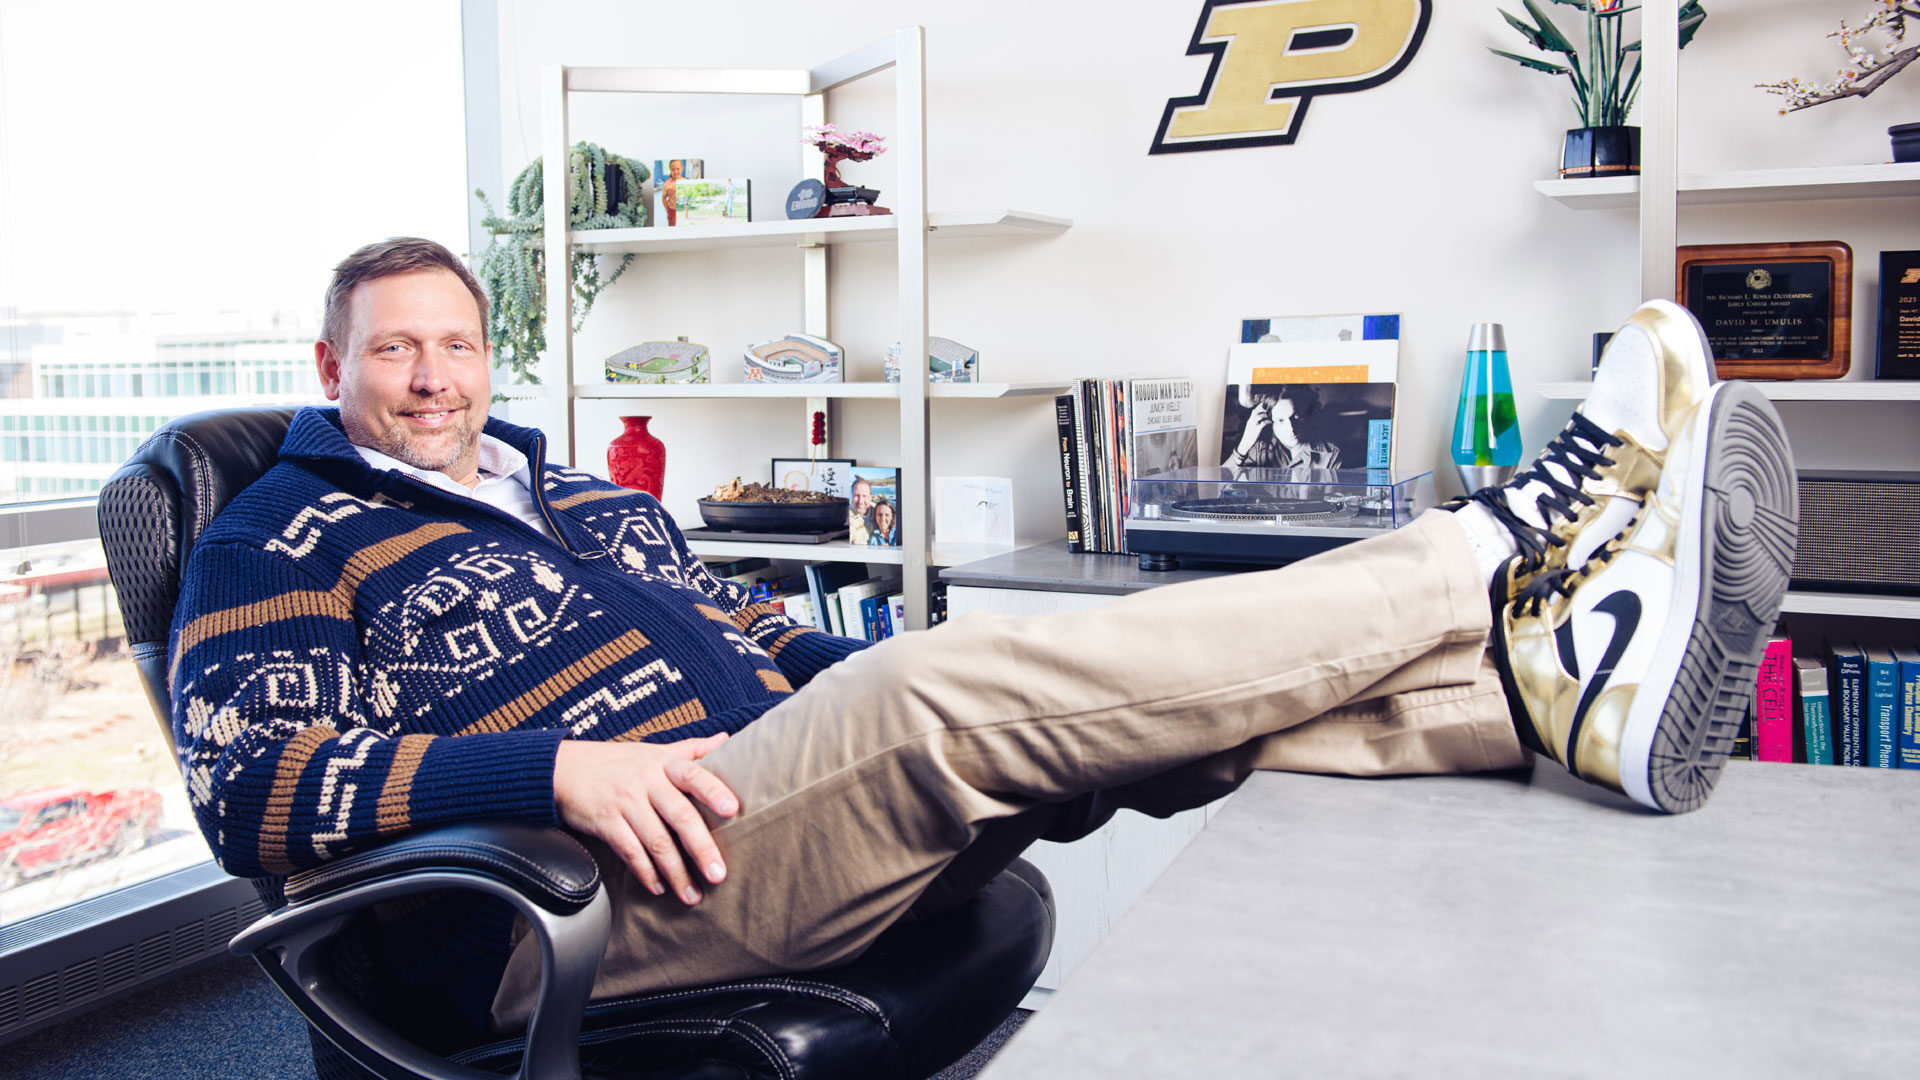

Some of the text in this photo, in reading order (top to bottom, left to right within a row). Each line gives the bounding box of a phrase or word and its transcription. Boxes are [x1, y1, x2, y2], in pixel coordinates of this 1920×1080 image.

[1149, 0, 1433, 155] P
[1765, 318, 1802, 326] UMULIS
[1135, 382, 1190, 401] HOODOO MAN BLUES
[1381, 443, 1389, 464] WHITE
[1066, 489, 1074, 509] Brain
[1762, 654, 1777, 724] THE CELL
[1904, 682, 1914, 704] Surface
[1810, 702, 1820, 748] Thermodynamics
[1878, 704, 1893, 742] Transport
[1902, 706, 1914, 735] Chemistry
[1852, 717, 1860, 758] DIFFERENTIAL
